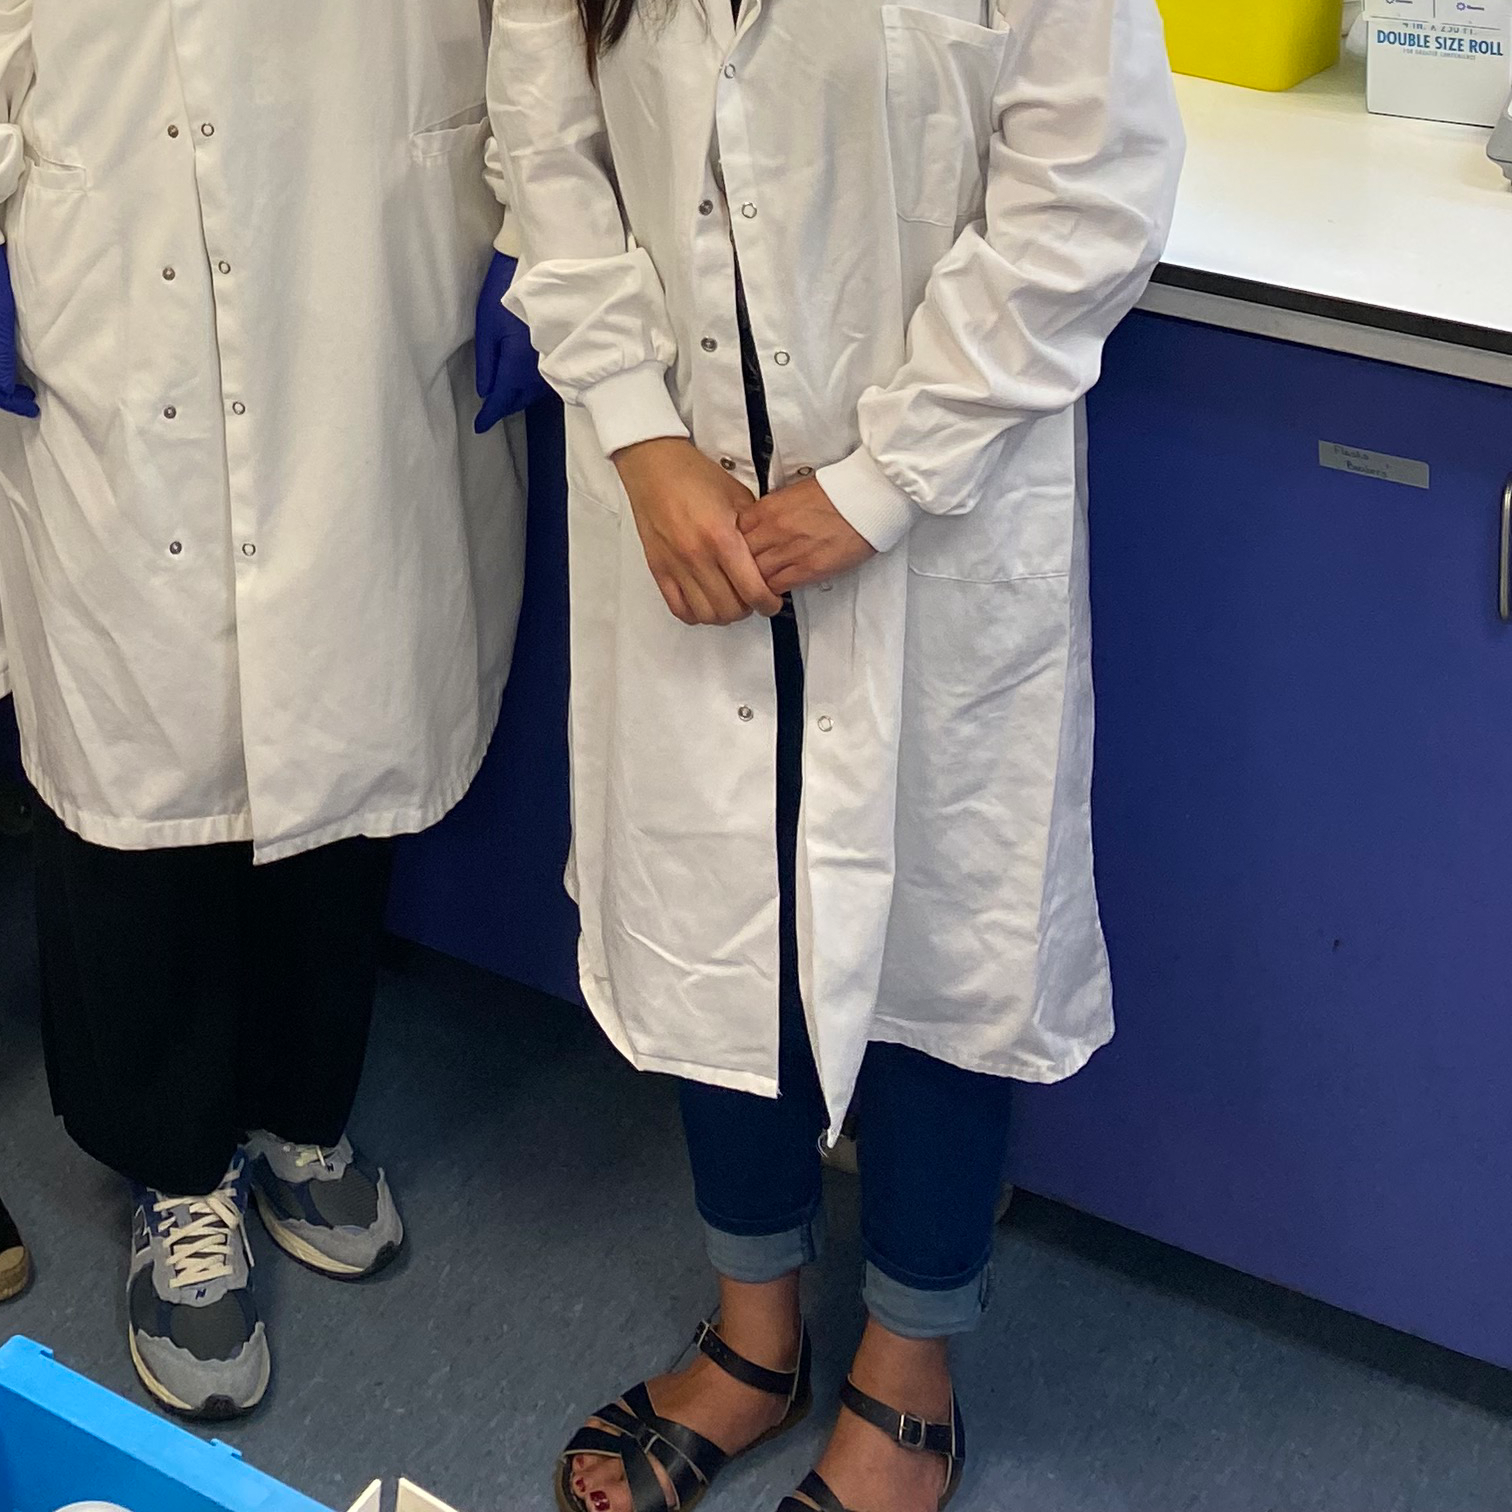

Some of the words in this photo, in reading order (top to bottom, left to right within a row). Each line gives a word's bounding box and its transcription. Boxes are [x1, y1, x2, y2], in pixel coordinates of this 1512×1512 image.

[1377, 30, 1430, 48] DOUBLE
[1435, 36, 1465, 52] SIZE
[1469, 39, 1504, 56] ROLL
